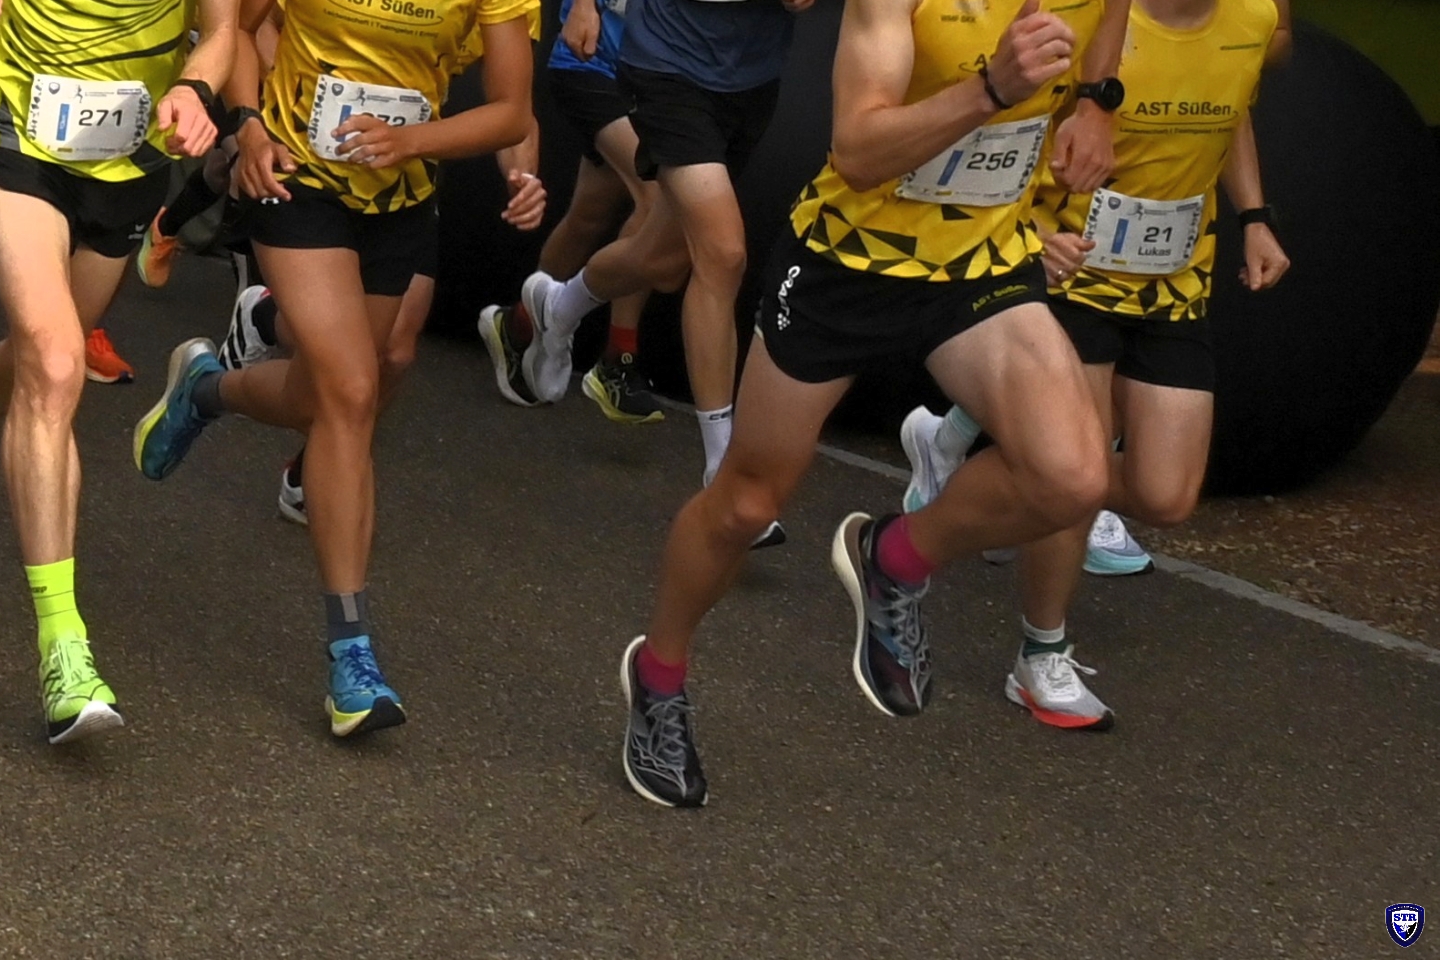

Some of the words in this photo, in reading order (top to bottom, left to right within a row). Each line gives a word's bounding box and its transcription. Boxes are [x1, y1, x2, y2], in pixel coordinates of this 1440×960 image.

[1134, 101, 1173, 116] AST
[1177, 101, 1231, 116] Süßen
[78, 109, 123, 126] 271
[966, 149, 1019, 171] 256
[1143, 226, 1173, 243] 21
[1138, 246, 1172, 256] Lukas
